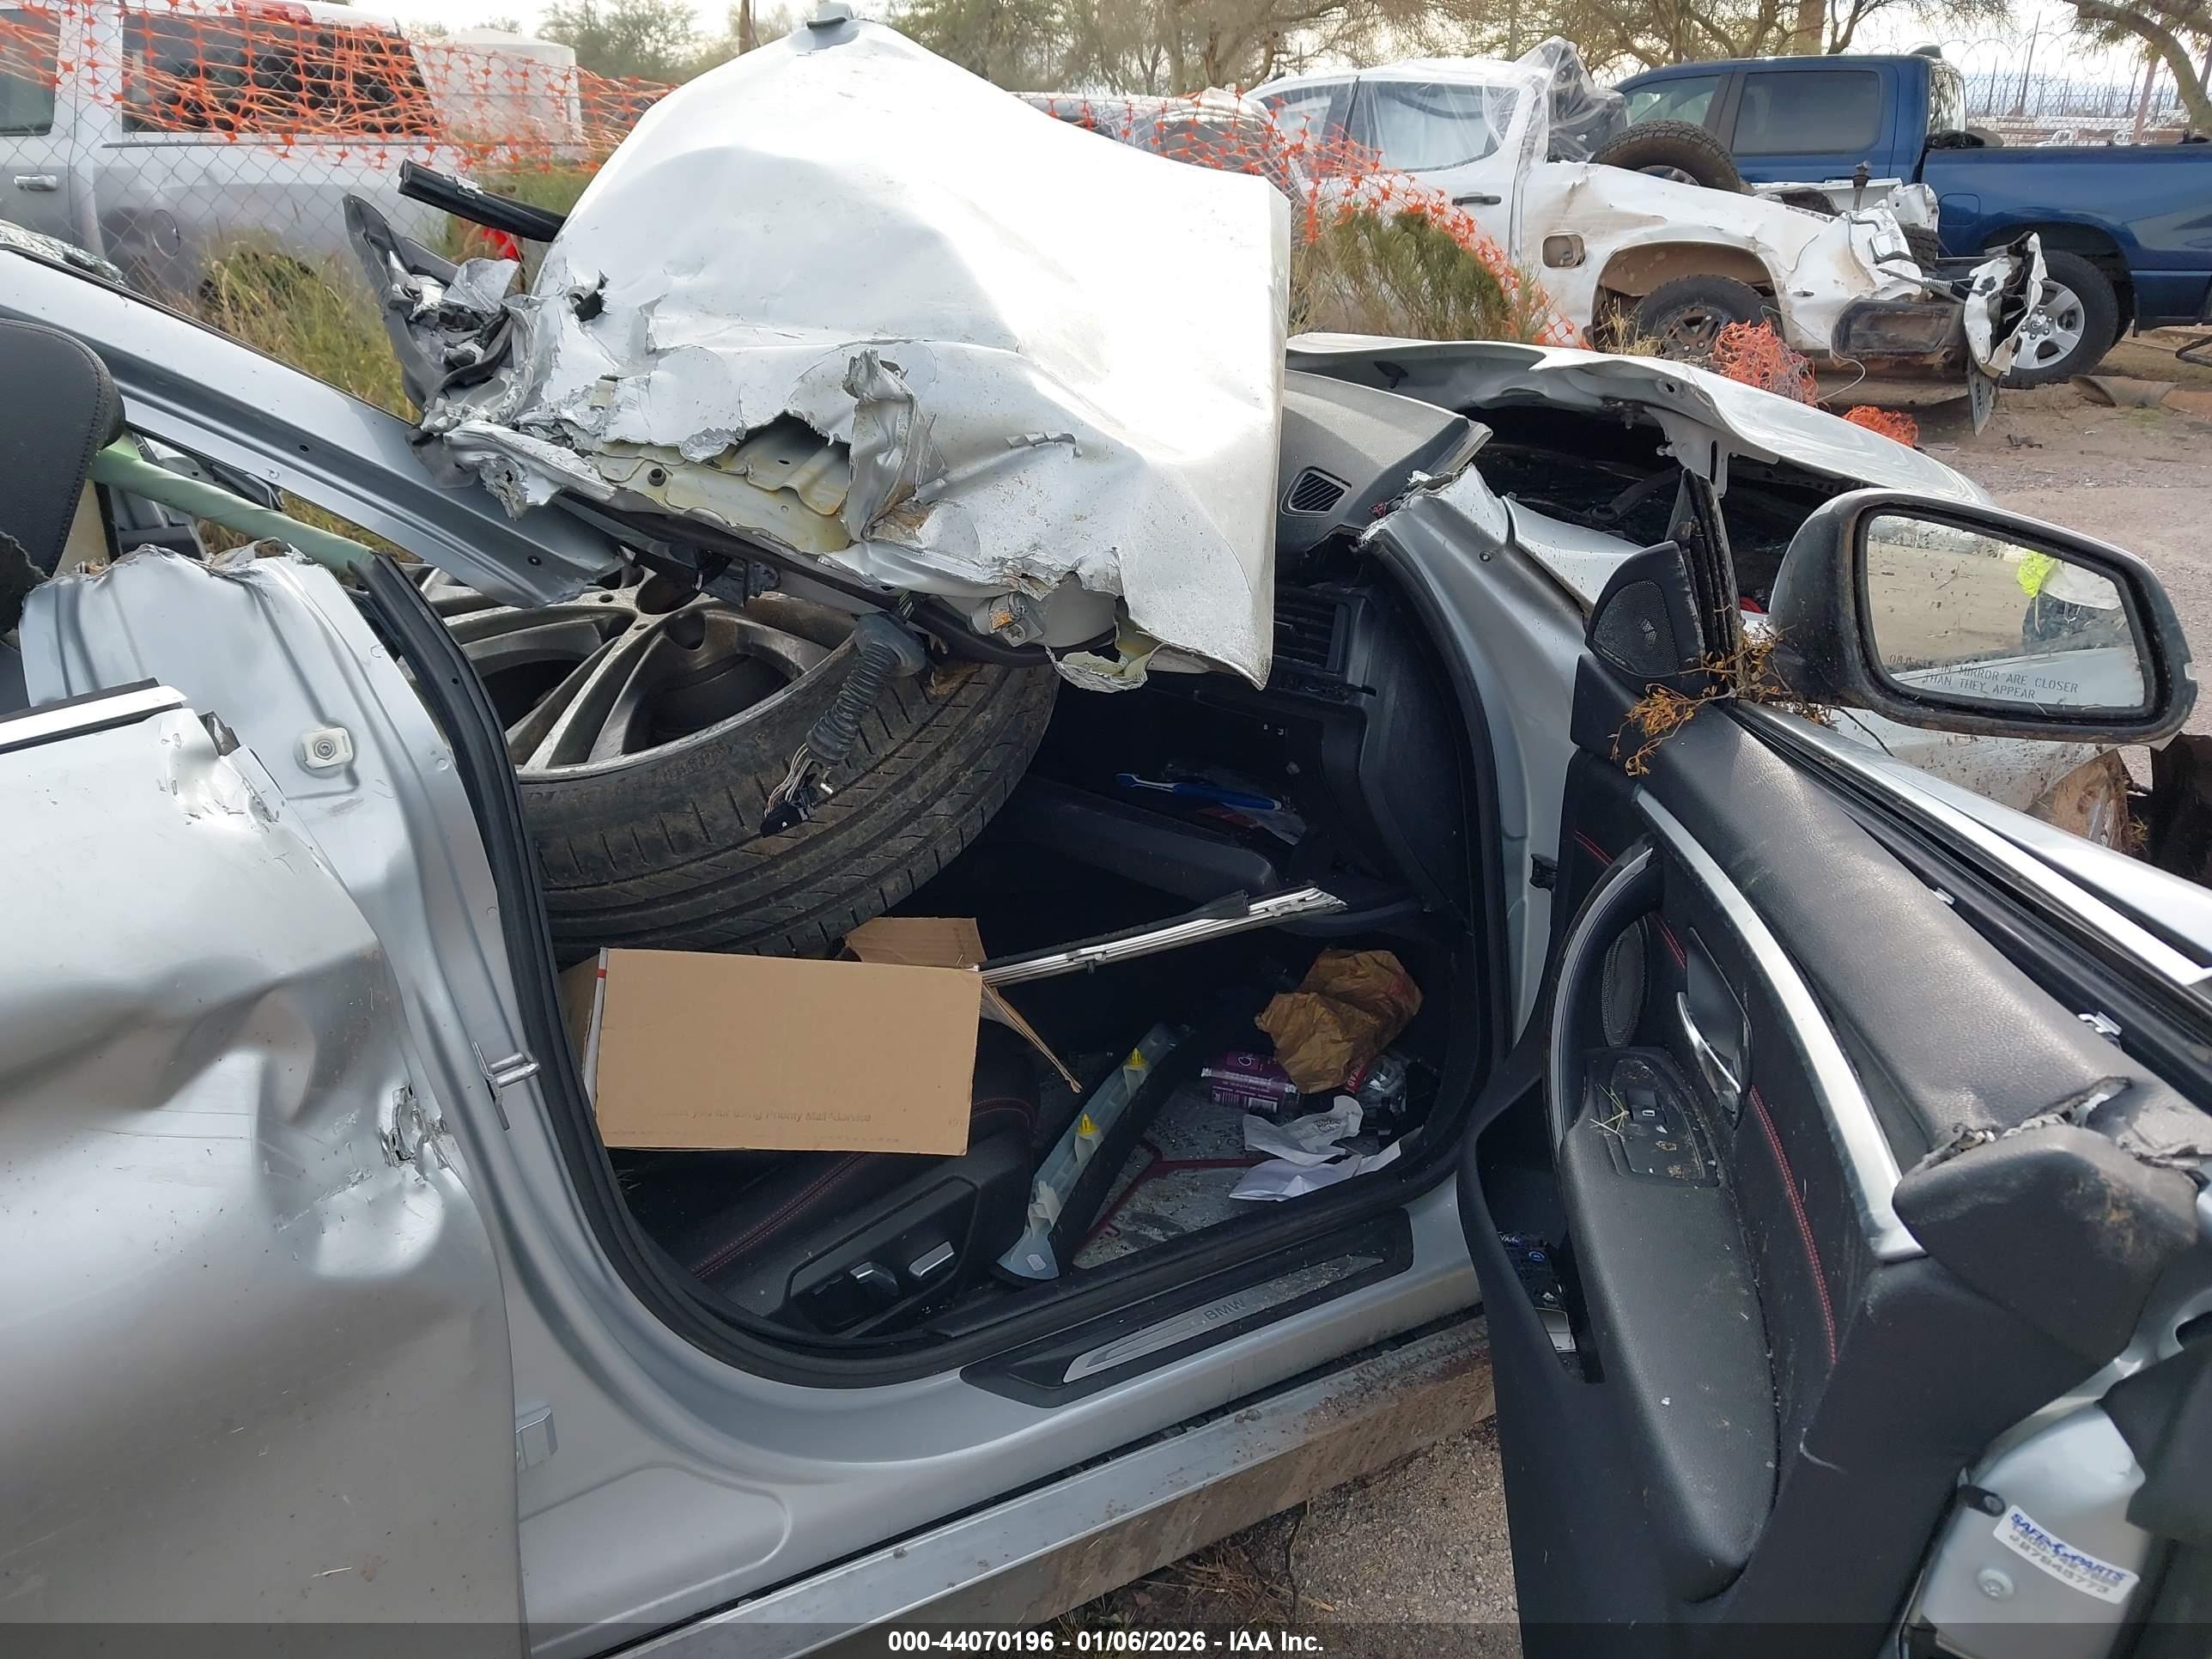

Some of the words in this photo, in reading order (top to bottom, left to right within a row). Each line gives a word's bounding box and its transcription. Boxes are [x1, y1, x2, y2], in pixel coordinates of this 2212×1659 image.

[1924, 672, 1952, 686] THAN
[1960, 678, 1985, 692] THEY
[1992, 685, 2036, 700] APPEAR
[1941, 663, 1952, 673] IN
[1959, 665, 2000, 681] MIRROR
[2006, 674, 2027, 685] ARE
[2034, 678, 2079, 694] CLOSER
[1203, 1298, 1245, 1321] BMW
